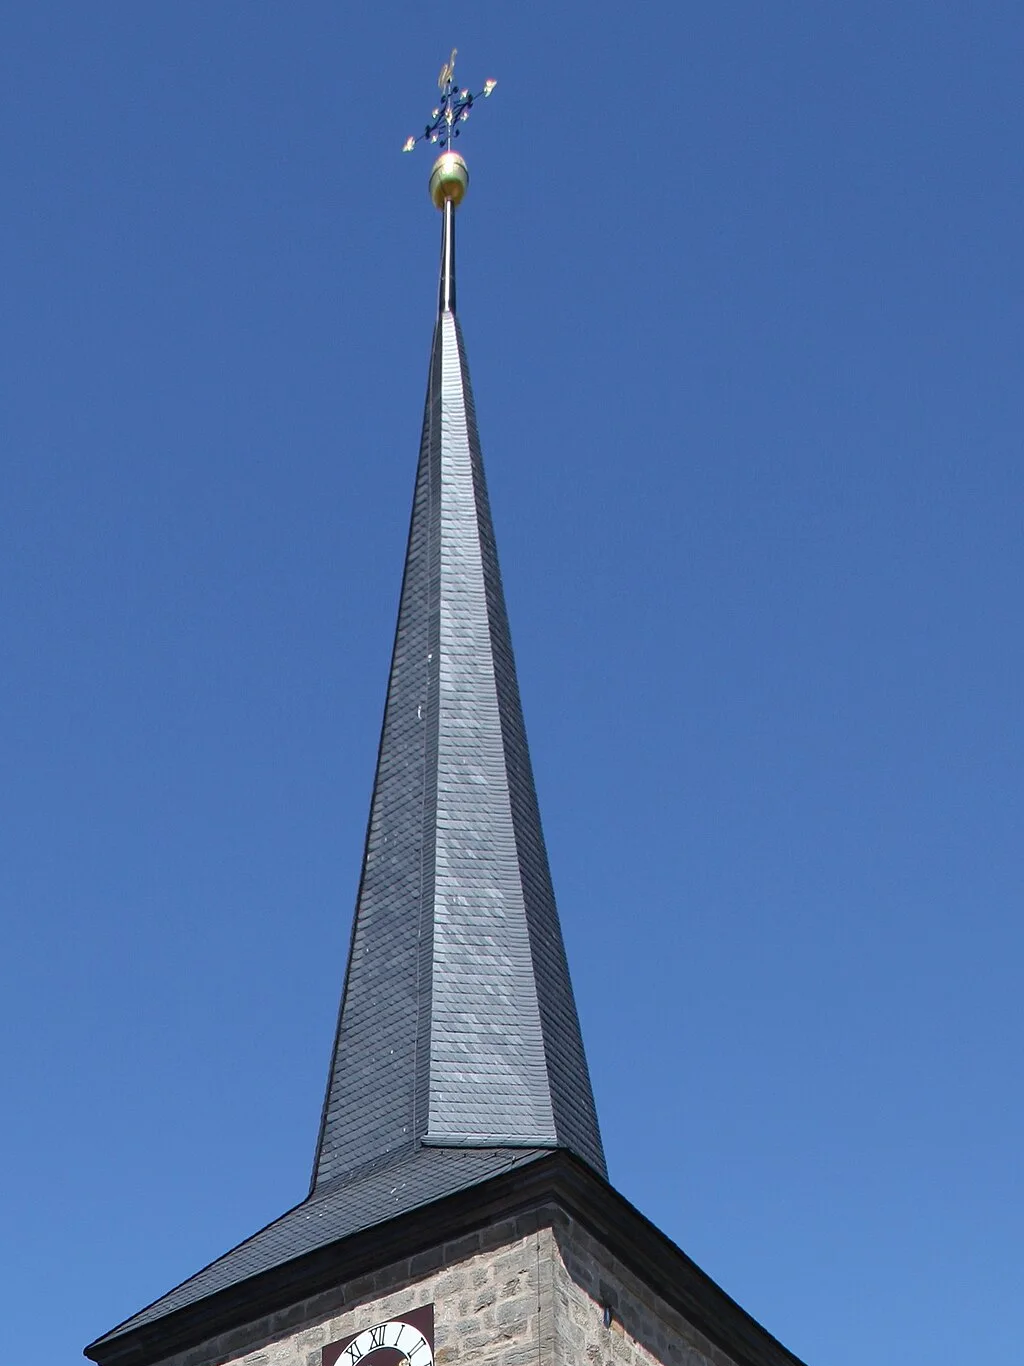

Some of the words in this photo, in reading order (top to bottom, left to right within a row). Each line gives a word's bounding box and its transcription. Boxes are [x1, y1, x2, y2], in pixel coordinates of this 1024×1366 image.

[368, 1324, 387, 1351] XII
[394, 1325, 405, 1346] I
[344, 1341, 363, 1366] XI
[407, 1337, 426, 1358] II
